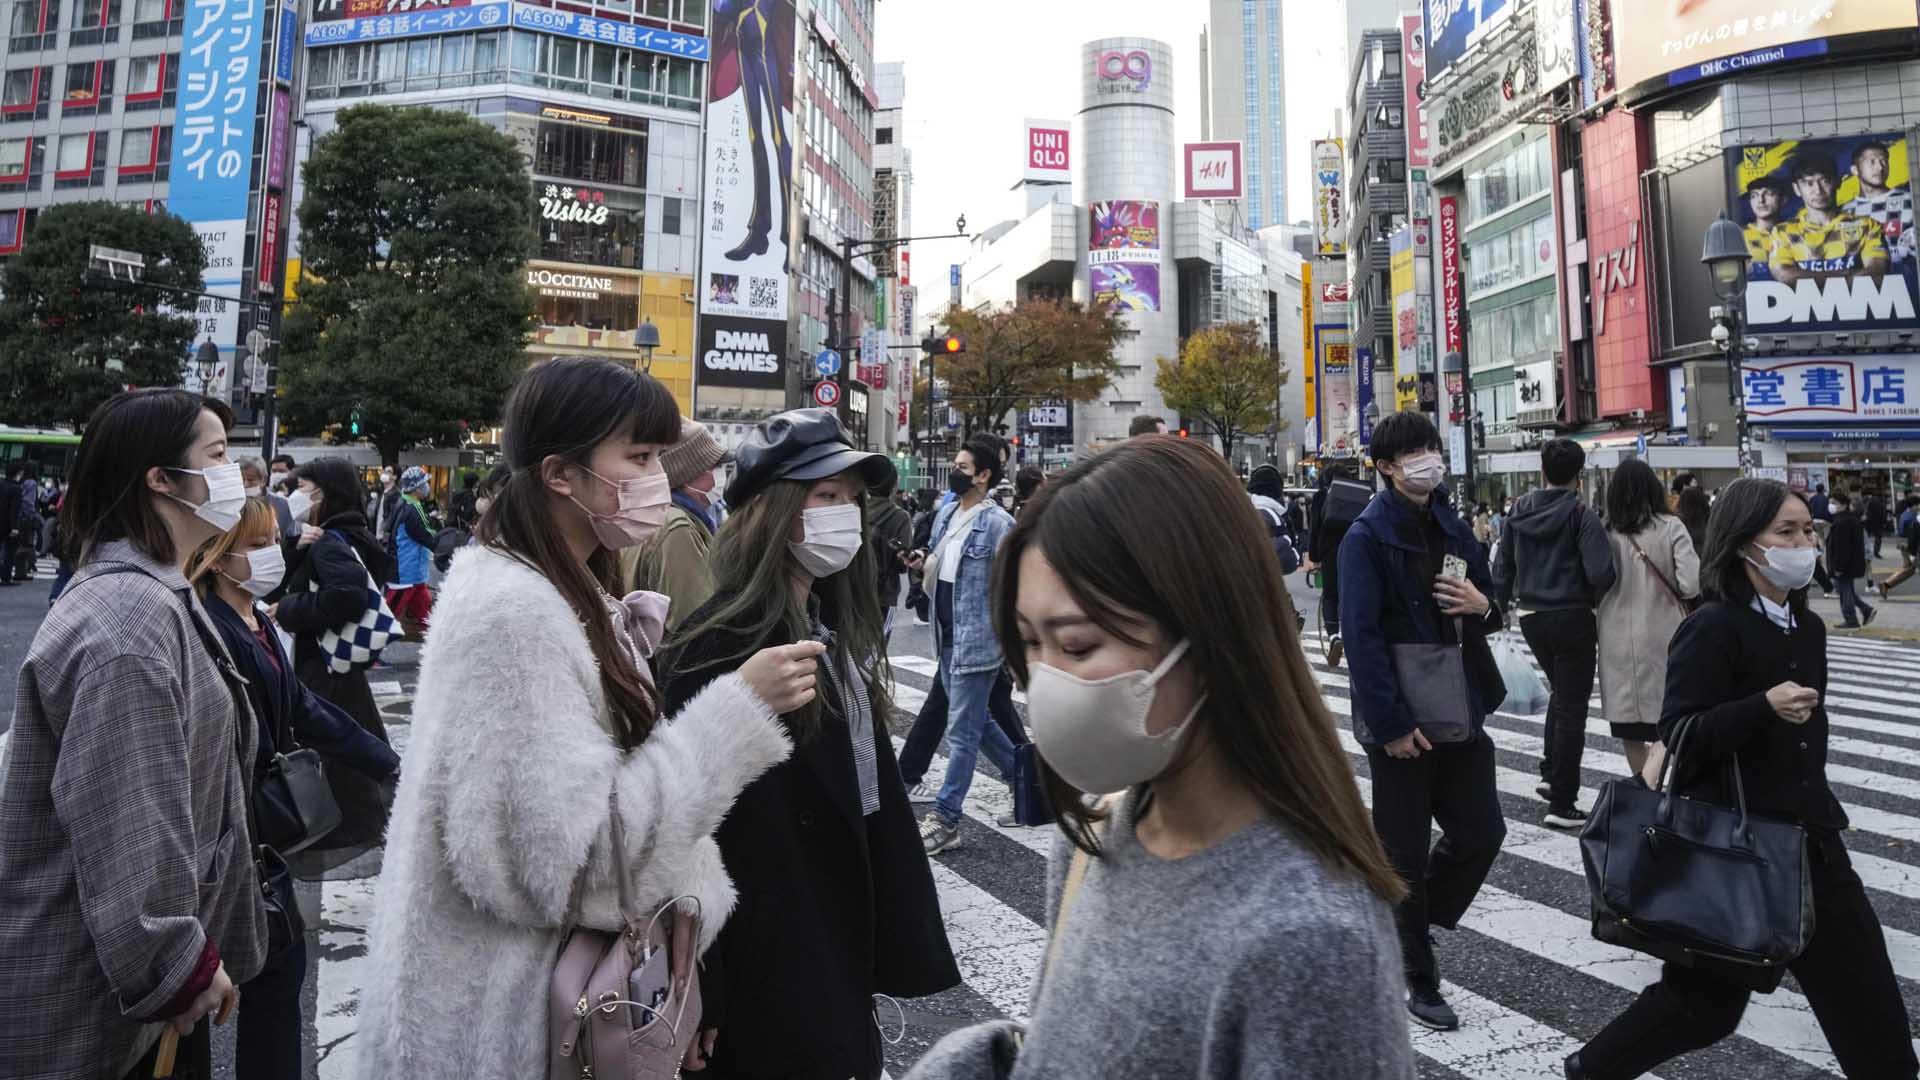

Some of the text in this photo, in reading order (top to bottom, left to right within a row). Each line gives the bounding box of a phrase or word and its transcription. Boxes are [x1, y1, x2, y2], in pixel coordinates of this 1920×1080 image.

[311, 25, 348, 40] AEON
[360, 12, 474, 38] 英会話イーオン
[521, 9, 705, 54] AEON 英会話イーオン
[1700, 48, 1785, 76] DHC Channel
[183, 0, 226, 180] アイシティ
[217, 0, 254, 178] コンタクトの
[1033, 132, 1063, 149] UNI
[1033, 149, 1066, 167] QLO
[1199, 160, 1227, 179] H&M
[192, 231, 227, 243] NTACT
[527, 270, 612, 291] L'OCCITANE
[1442, 217, 1460, 344] ウィンターフルーツギフト
[1595, 220, 1640, 336] クスリ
[557, 290, 598, 300] PROVENCE
[1746, 274, 1917, 325] DMM
[715, 329, 770, 352] DMM
[704, 350, 779, 373] GAMES
